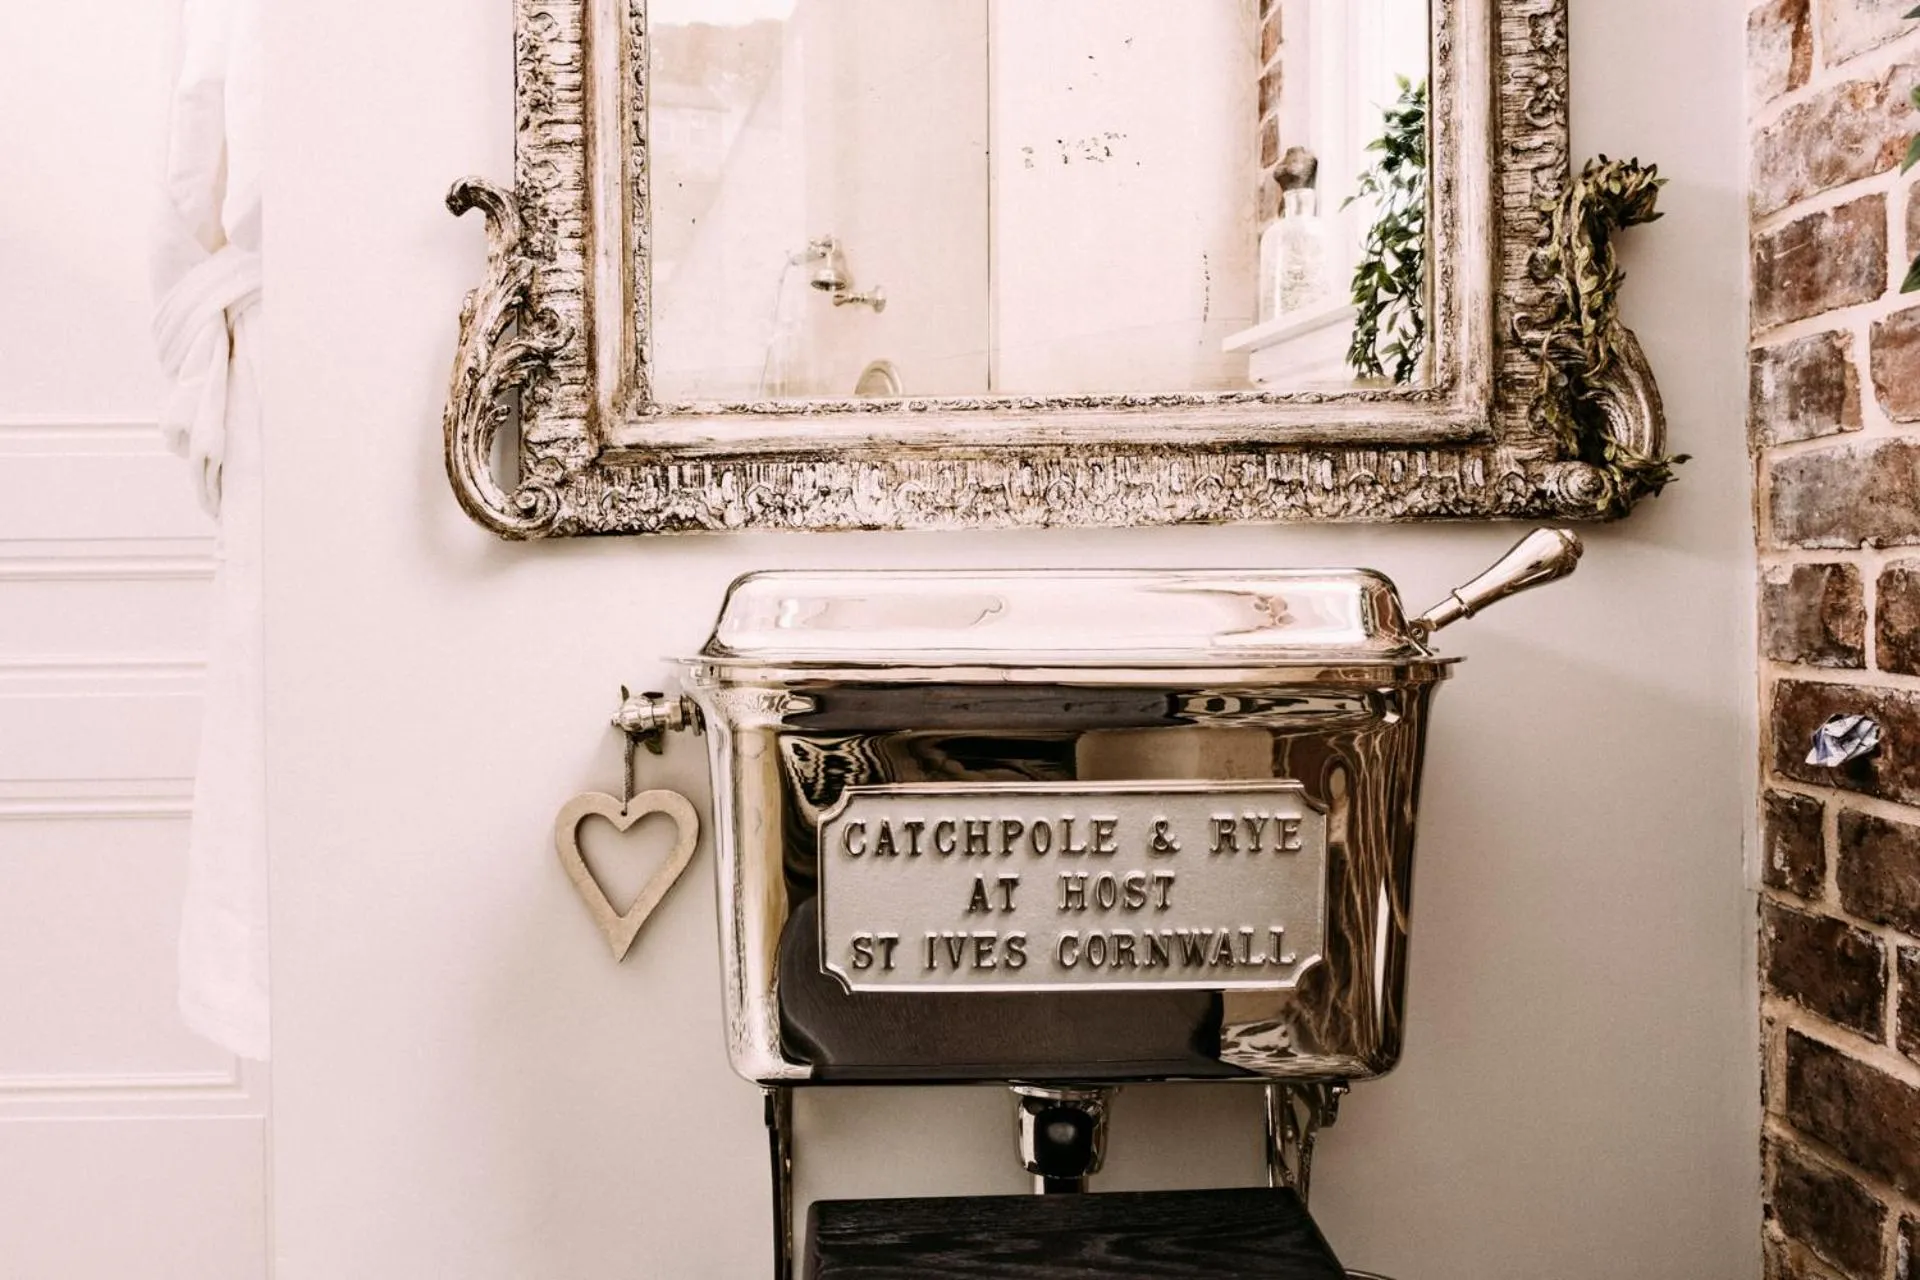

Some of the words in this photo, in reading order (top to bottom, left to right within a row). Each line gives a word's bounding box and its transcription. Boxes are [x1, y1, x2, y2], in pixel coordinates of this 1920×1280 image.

[843, 813, 1118, 856] CATCHPOLE
[1149, 816, 1181, 853] &
[1209, 811, 1302, 853] RYE
[967, 873, 1020, 912] AT
[1058, 870, 1176, 911] HOST
[851, 932, 899, 970] ST
[924, 930, 1028, 969] IVES
[1056, 926, 1297, 968] CORNWALL
